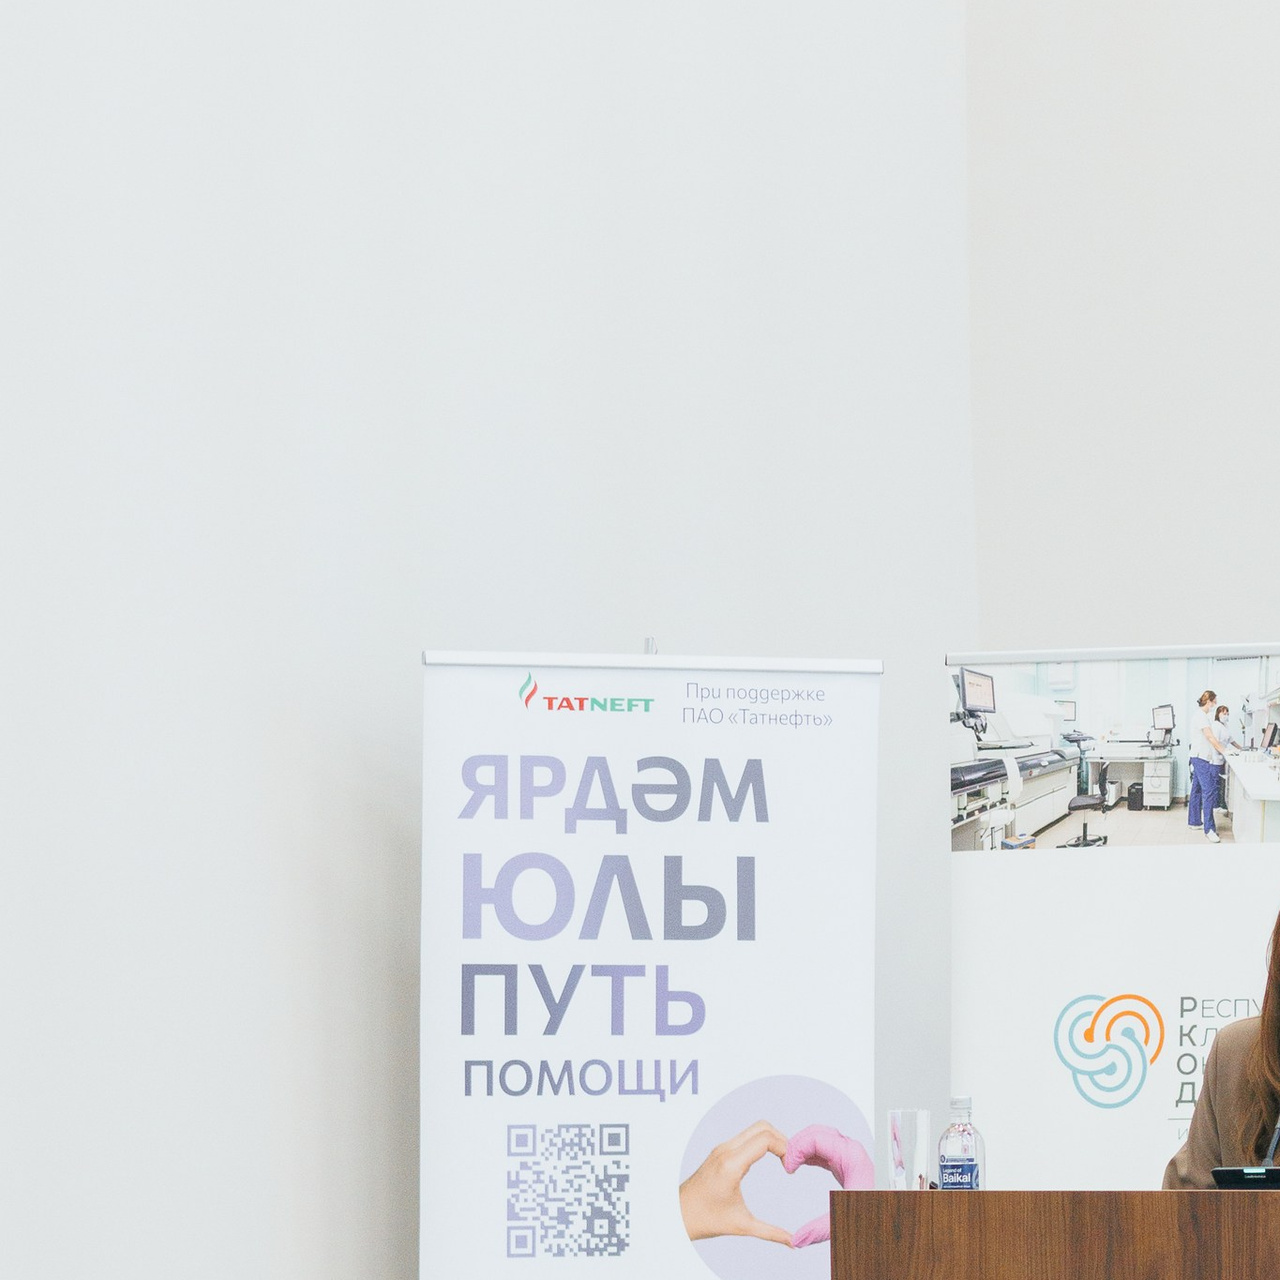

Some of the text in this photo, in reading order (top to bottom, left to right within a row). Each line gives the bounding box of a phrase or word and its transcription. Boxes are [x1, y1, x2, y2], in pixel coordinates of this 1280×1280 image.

[542, 696, 655, 713] TATNEFT
[685, 681, 826, 705] При поддержке
[682, 706, 834, 730] ПАО «Татнефть»
[457, 754, 770, 835] ЯРДӘМ
[462, 852, 757, 942] ЮЛЫ
[460, 963, 706, 1037] ПУТЬ
[463, 1058, 699, 1103] ПОМОЩИ
[943, 1173, 971, 1183] Baikal
